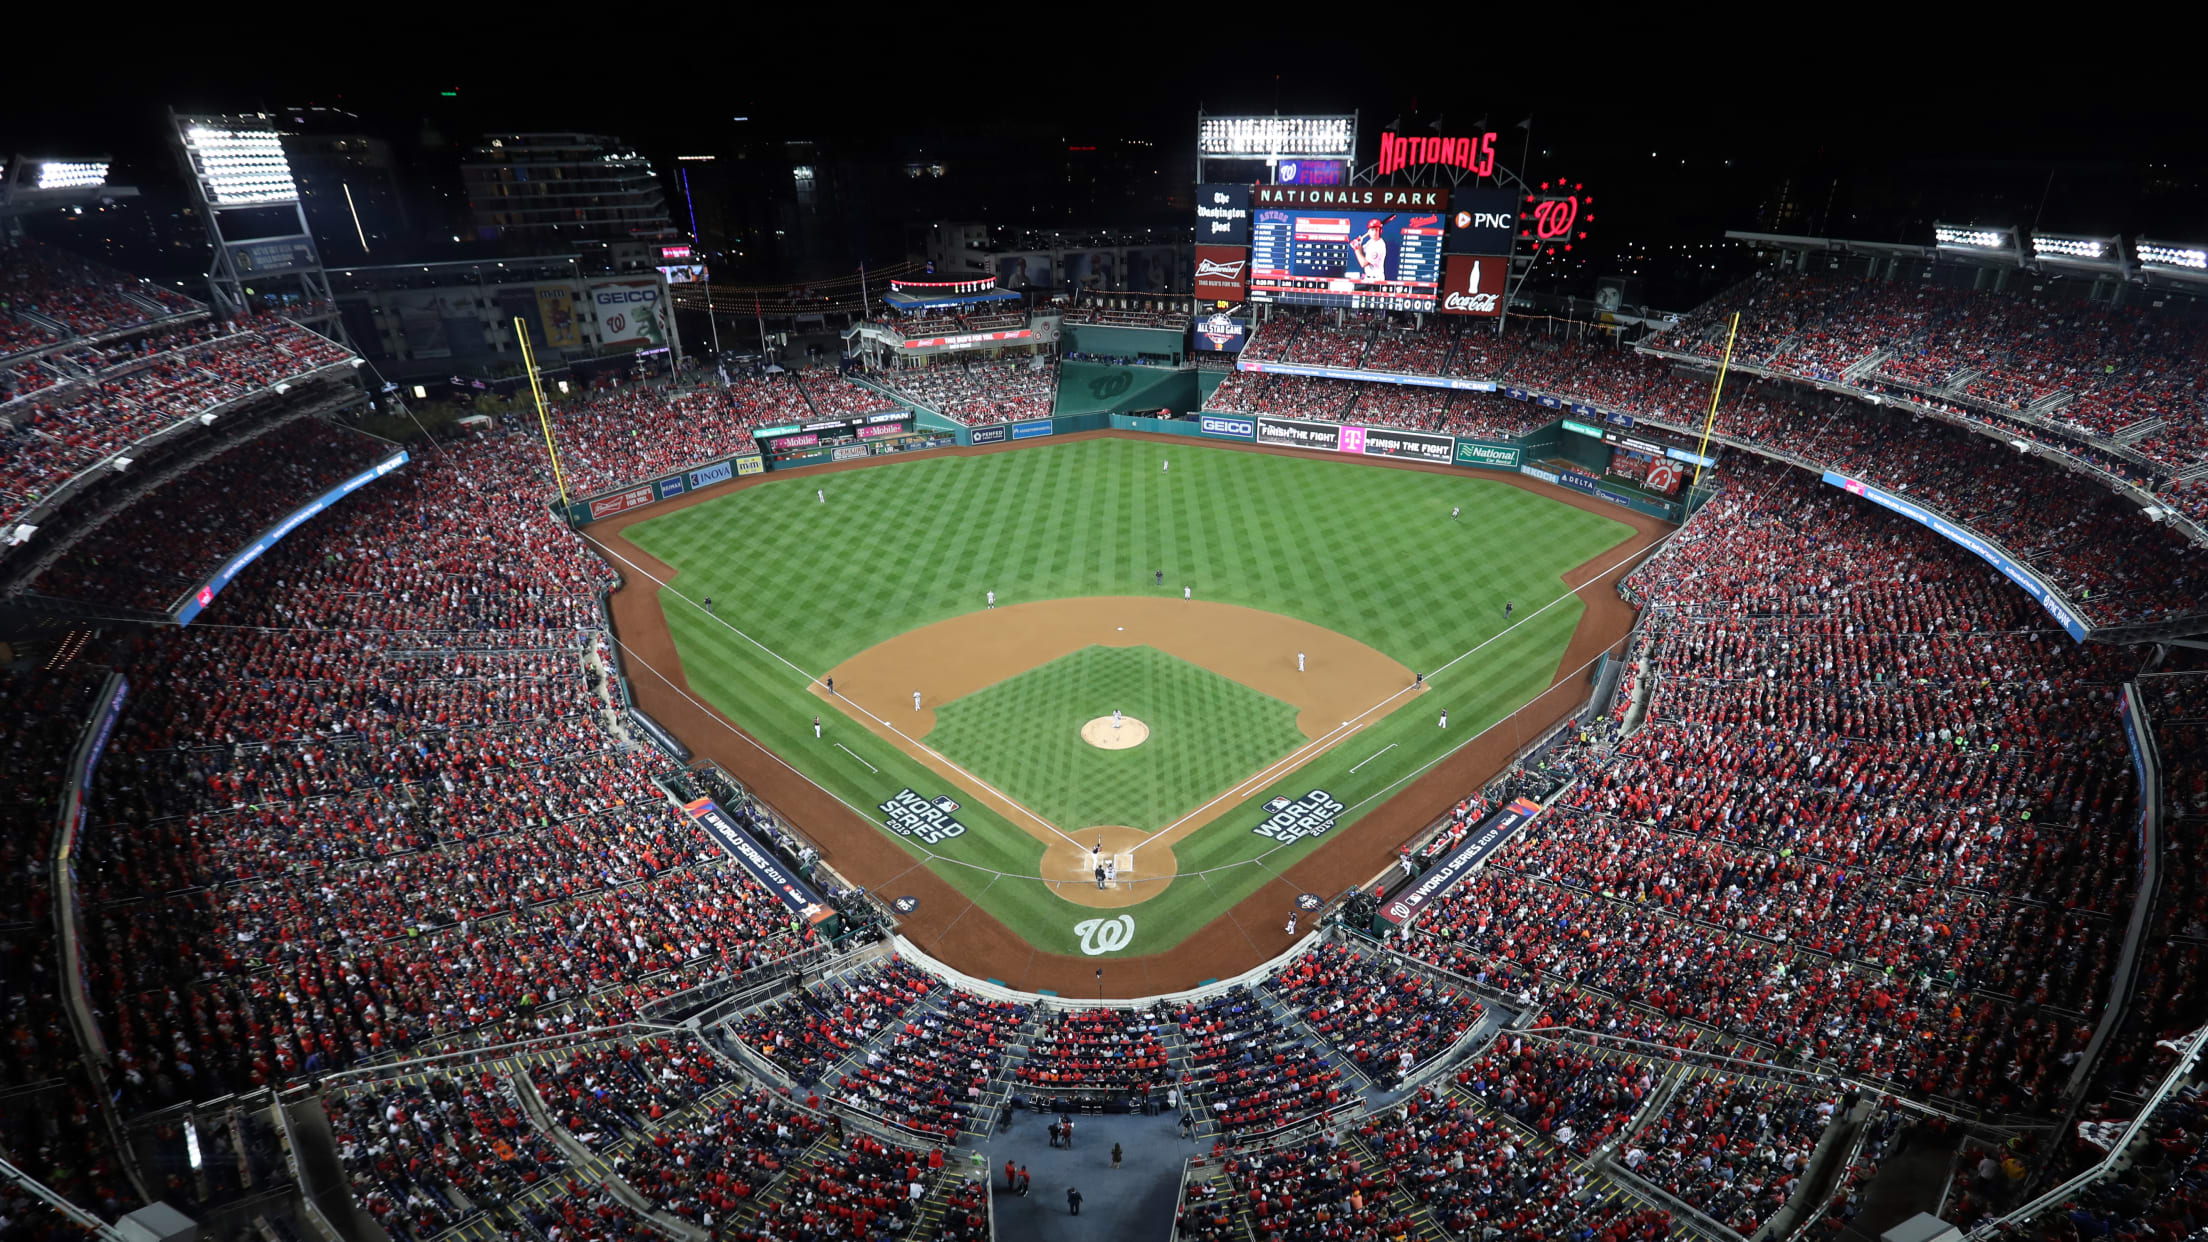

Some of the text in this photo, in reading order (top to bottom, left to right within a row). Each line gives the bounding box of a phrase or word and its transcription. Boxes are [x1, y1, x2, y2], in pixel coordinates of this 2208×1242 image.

[1379, 132, 1497, 177] NATIONALS
[1301, 170, 1341, 184] FIGHT
[1214, 192, 1230, 204] The
[1261, 190, 1437, 205] NATIONALS PARK
[1197, 204, 1246, 220] Washington
[1211, 221, 1231, 234] Post
[1474, 213, 1511, 229] PNC
[1200, 263, 1240, 273] Budweiser
[596, 290, 656, 304] GEICO
[1444, 291, 1500, 312] Coca-Cola
[1197, 323, 1242, 335] ALL STAR GAME
[1203, 420, 1251, 434] GEICO
[1262, 427, 1290, 437] FINISH
[1292, 429, 1307, 440] THE
[1370, 438, 1449, 455] FINISH THE FIGHT
[701, 466, 730, 482] INOVA
[1531, 467, 1557, 482] KOCH
[1568, 477, 1593, 489] DELTA
[895, 788, 965, 837] WORLD
[1253, 790, 1330, 837] WORLD
[880, 800, 946, 844] SERIES
[886, 820, 911, 835] 2019
[1276, 800, 1343, 844] SERIES
[1310, 820, 1334, 837] 2019
[714, 820, 786, 884] WORLD SERIES 2019
[1416, 868, 1453, 896] WORLD
[1450, 844, 1482, 871] SERIES
[1478, 829, 1499, 848] 2019
